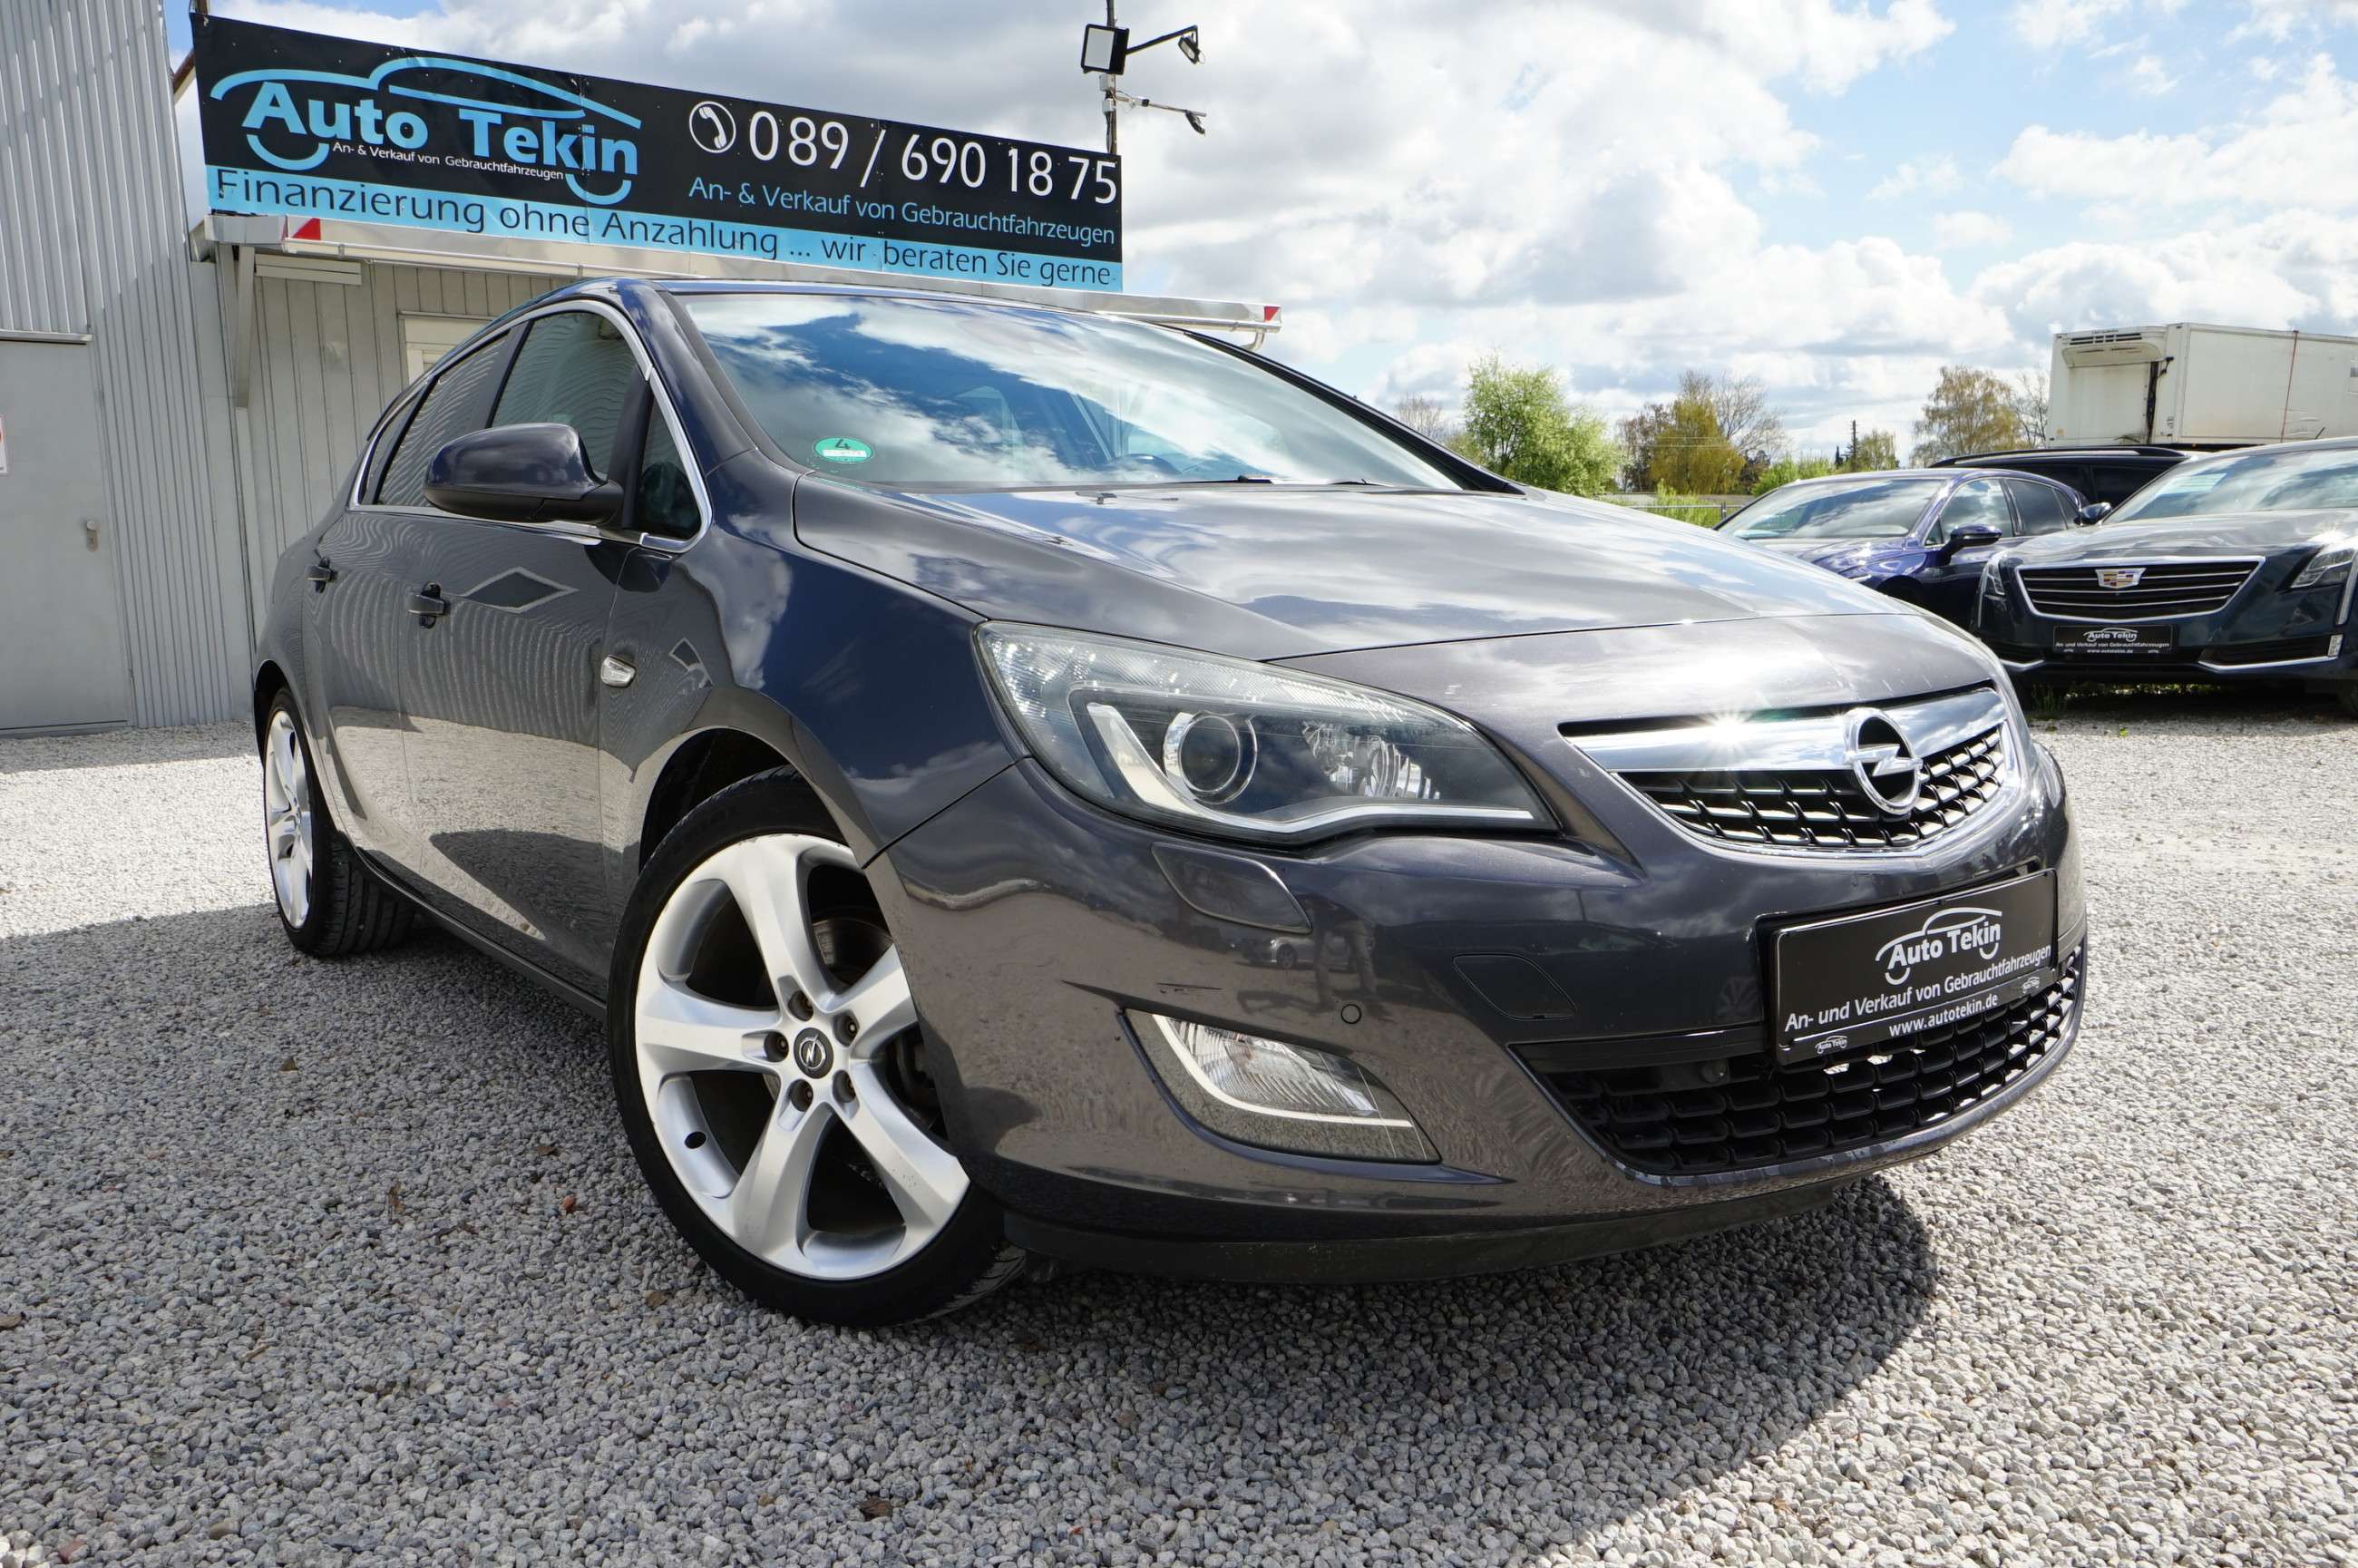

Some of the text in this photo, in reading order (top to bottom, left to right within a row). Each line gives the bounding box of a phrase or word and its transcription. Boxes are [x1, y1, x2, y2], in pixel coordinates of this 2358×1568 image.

[242, 81, 638, 175] Auto Tekin
[332, 141, 563, 180] An- & Verkauf von Gebrauchtfahrzeugen
[748, 110, 849, 170] 089
[901, 133, 986, 188] 690
[1008, 146, 1053, 197] 18
[1067, 156, 1117, 204] 75
[216, 168, 486, 234] Finanzierung
[499, 202, 590, 237] ohne
[601, 211, 778, 261] Anzahlung
[821, 236, 868, 263] wir
[883, 240, 988, 275] beraten
[996, 251, 1031, 278] Sie
[1038, 259, 1111, 287] gerne
[688, 176, 1116, 248] An- & Verkauf von Gebrauchtfahrzeugen
[1886, 920, 2002, 970] Auto Tekin
[1784, 1011, 1814, 1032] An-
[1817, 1001, 1850, 1026] und
[1855, 987, 1913, 1017] Verkauf
[1915, 983, 1941, 1003] von
[1944, 943, 2052, 994] Gebrauchtfahrzeugen
[1888, 994, 1999, 1037] www.autotekin.de
